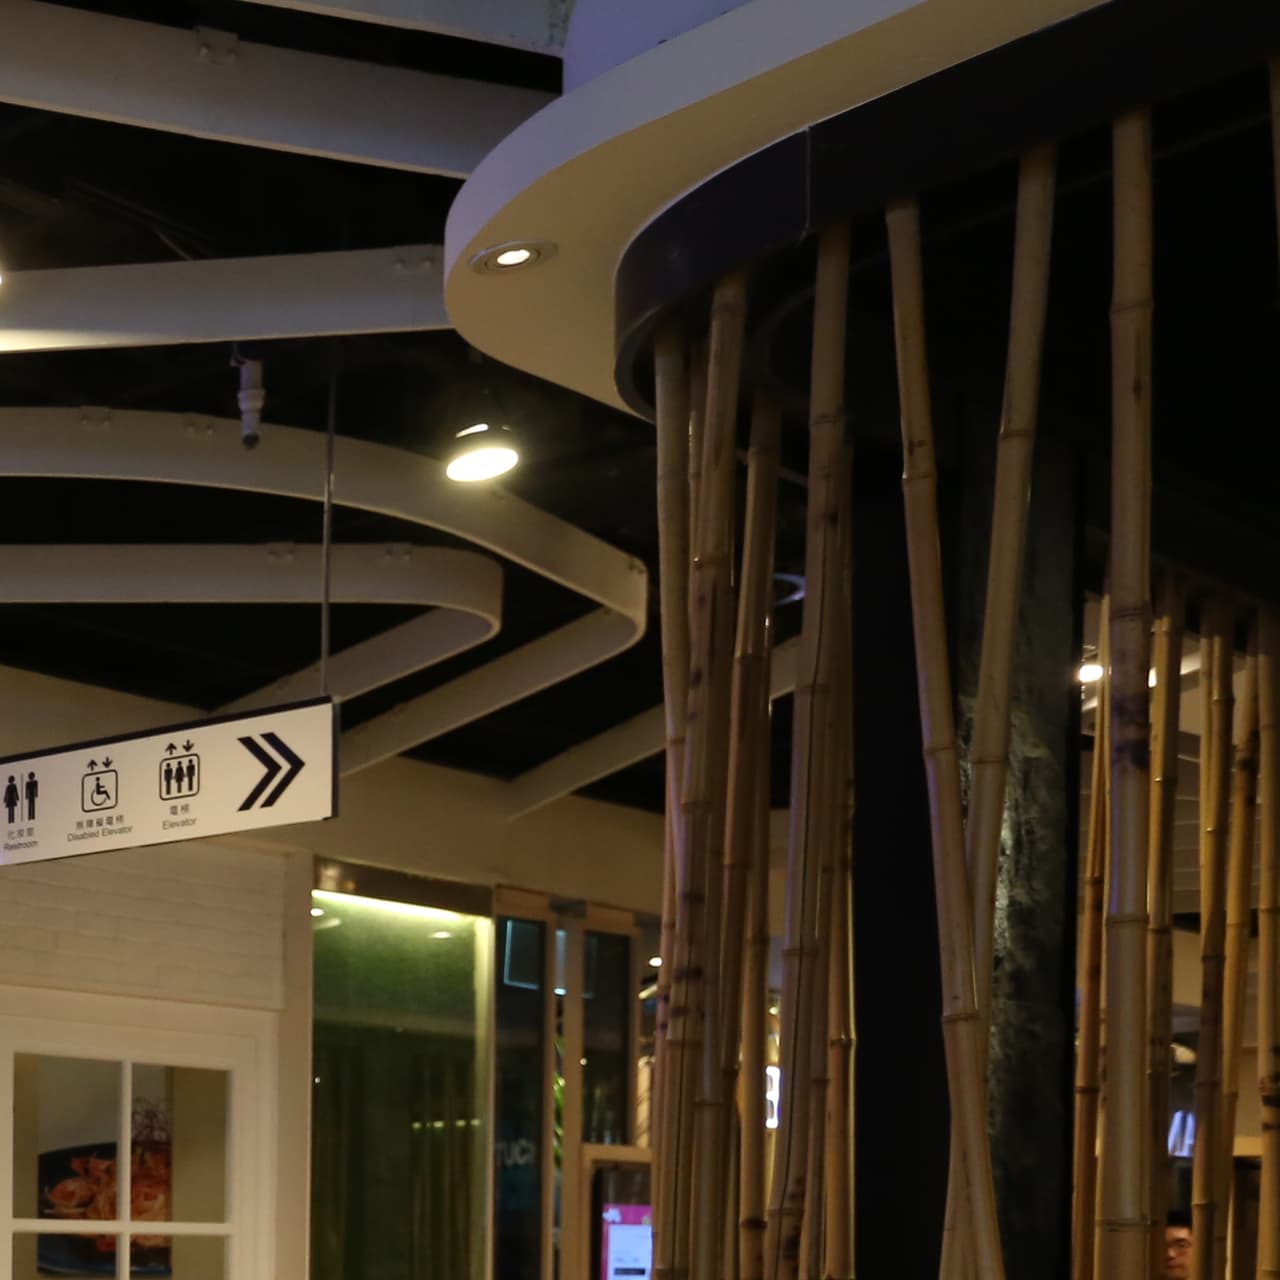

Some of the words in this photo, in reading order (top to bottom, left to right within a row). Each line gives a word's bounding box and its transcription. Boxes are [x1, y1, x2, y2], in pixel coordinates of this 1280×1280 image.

[161, 817, 197, 831] Elevator
[67, 828, 100, 842] Disabled
[101, 824, 134, 838] Elevator
[3, 839, 39, 852] Restroom
